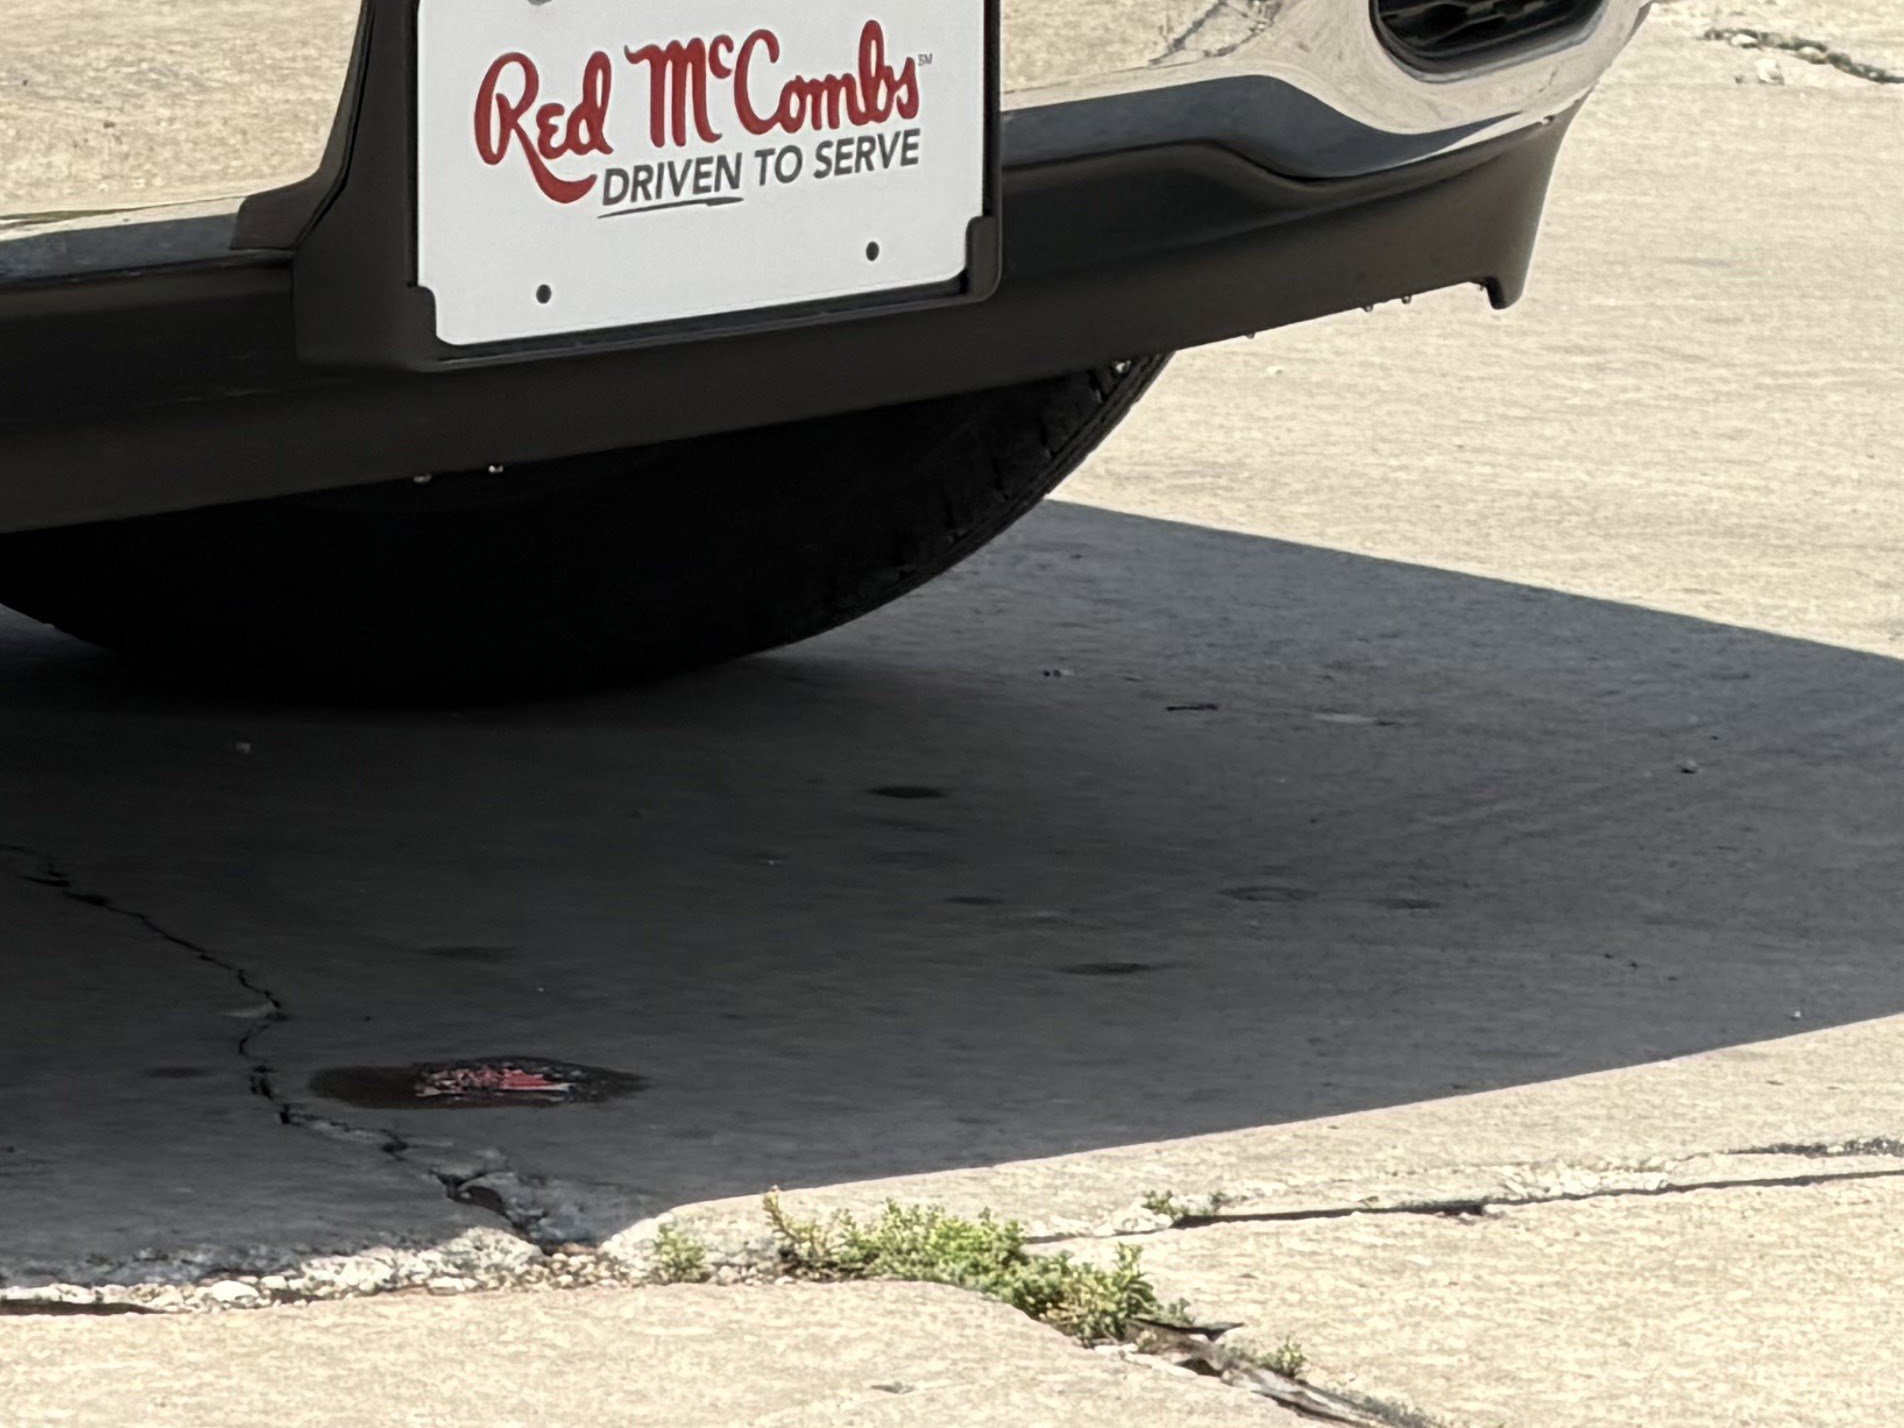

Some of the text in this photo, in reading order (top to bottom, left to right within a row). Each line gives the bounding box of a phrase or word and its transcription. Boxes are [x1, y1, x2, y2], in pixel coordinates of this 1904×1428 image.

[474, 50, 613, 204] Red
[623, 20, 919, 147] McCombs
[601, 127, 921, 207] DRIVEN TO SERVE
